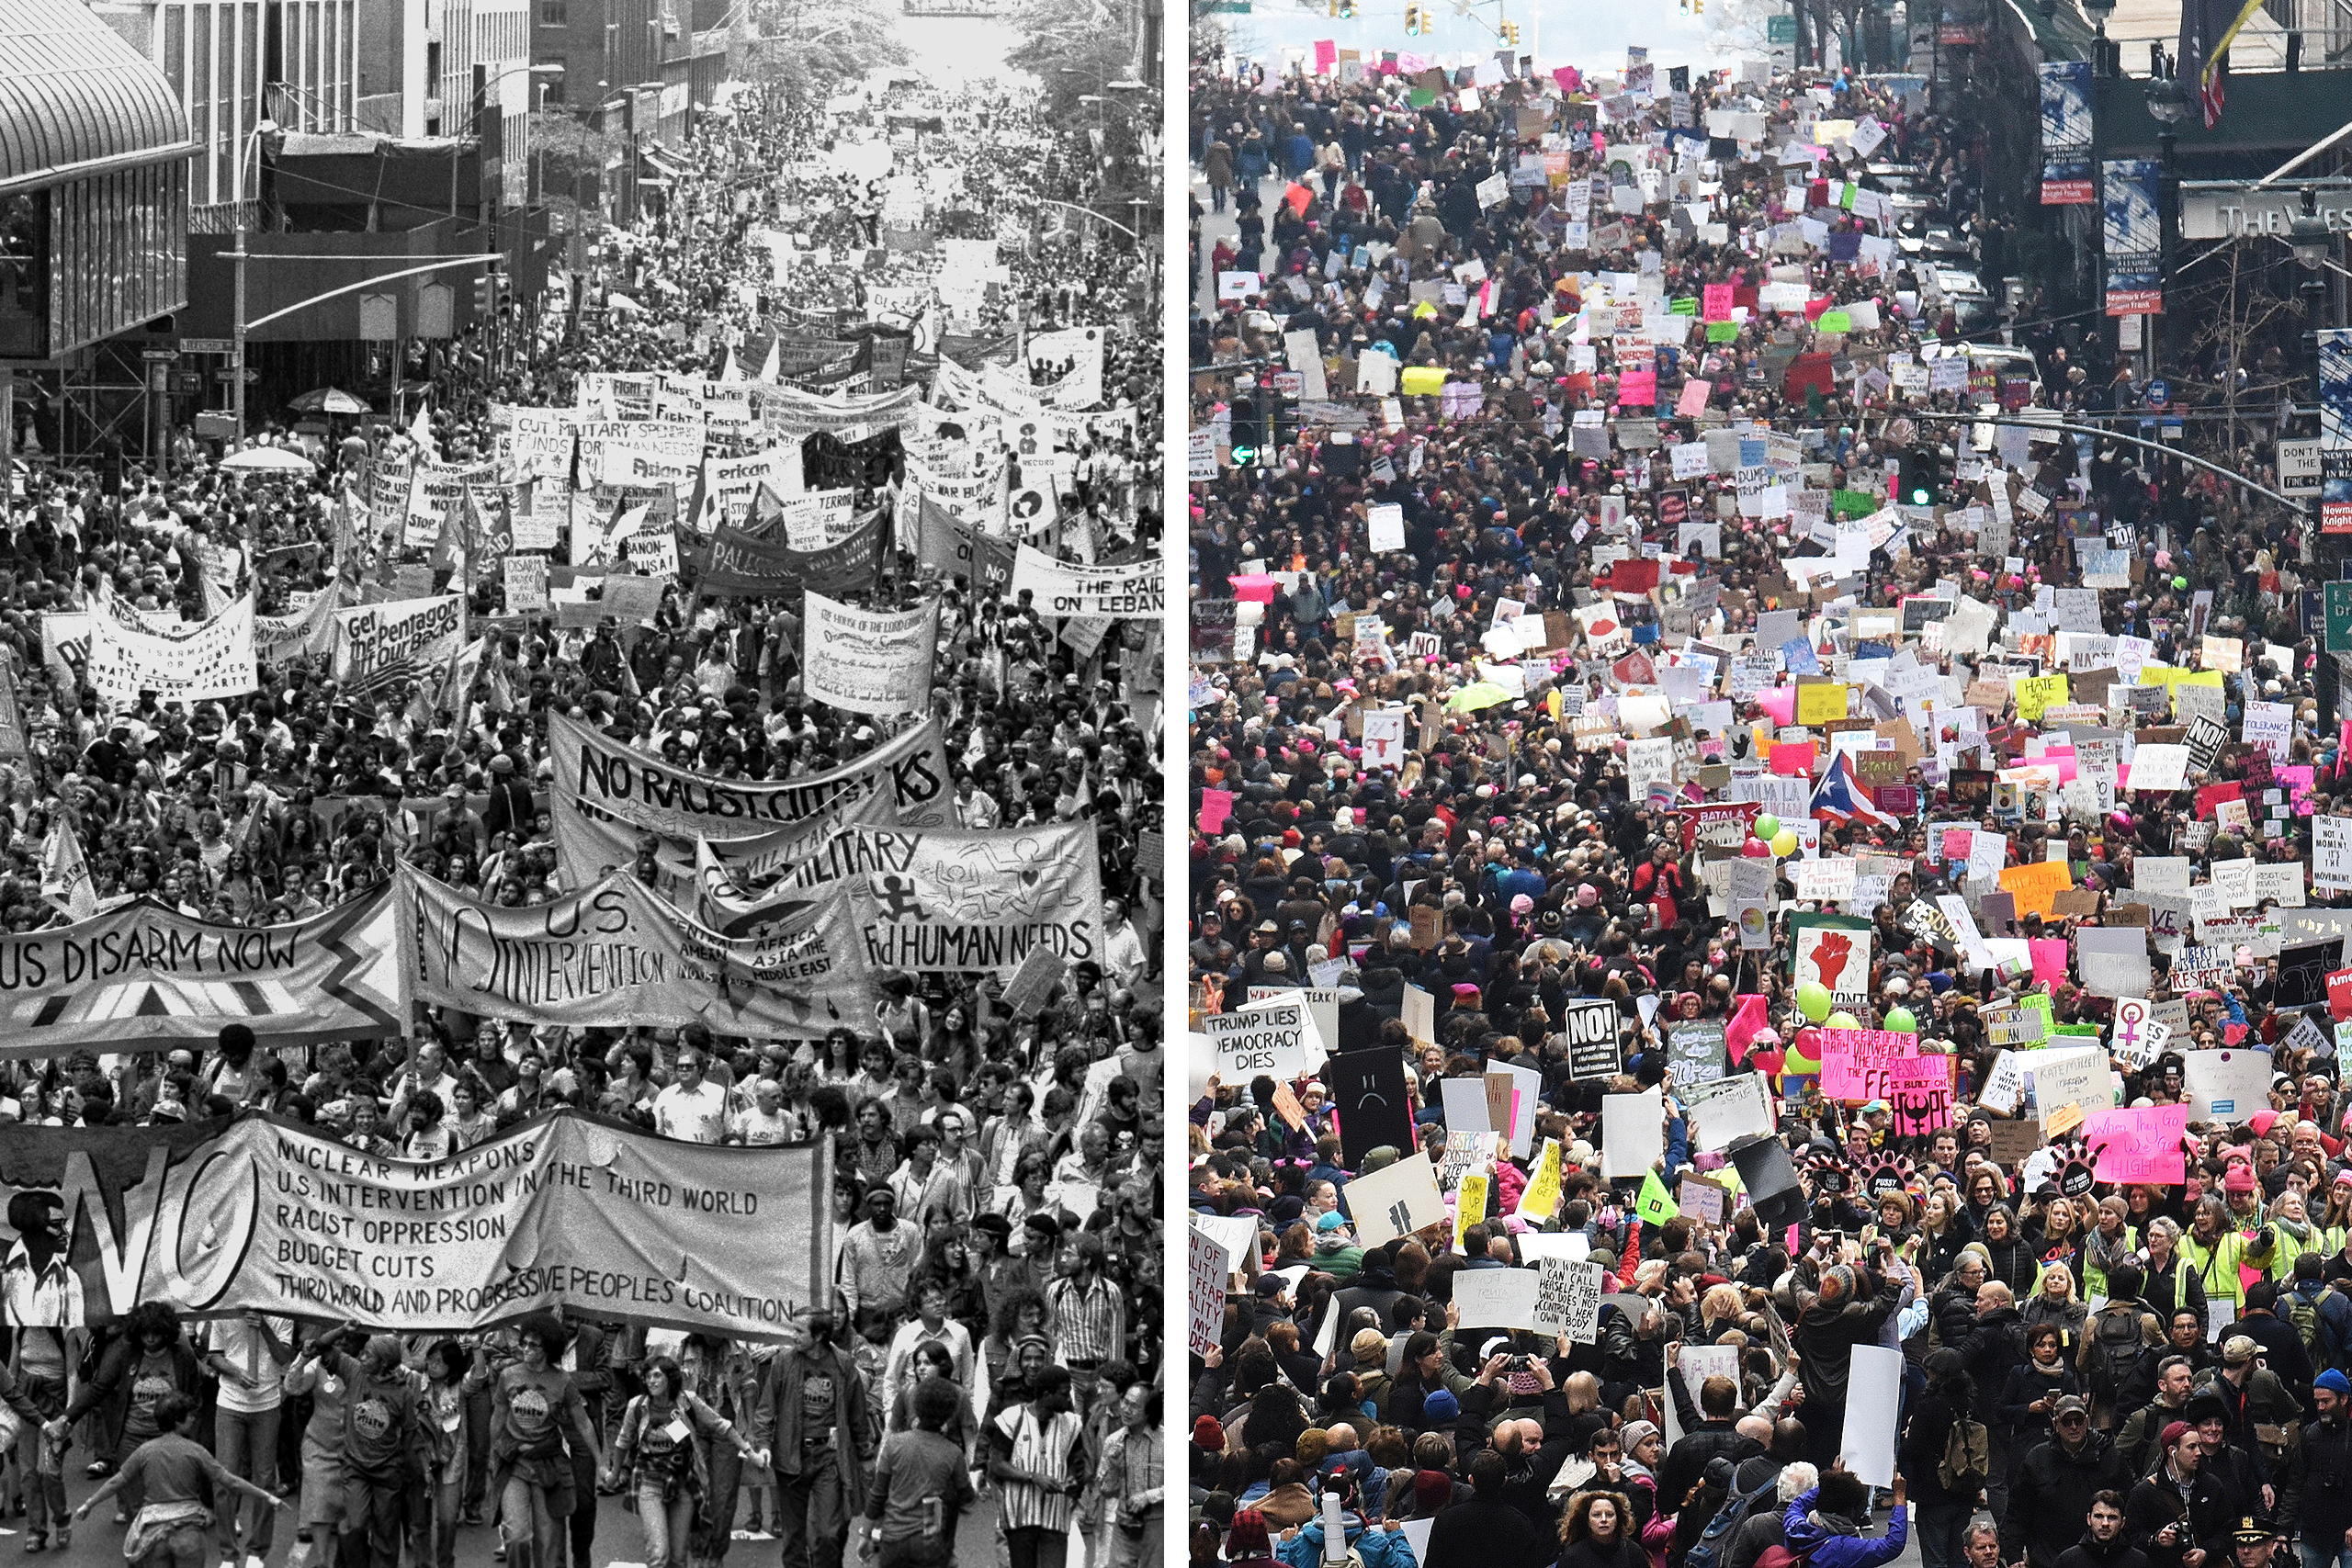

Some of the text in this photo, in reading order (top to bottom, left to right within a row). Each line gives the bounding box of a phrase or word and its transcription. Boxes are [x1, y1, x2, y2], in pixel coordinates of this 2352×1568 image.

[2220, 205, 2279, 231] THE
[518, 417, 630, 439] CUT MILITARY
[2283, 447, 2313, 458] DON'T
[383, 463, 404, 477] OUT
[633, 457, 682, 479] Asian
[2297, 458, 2316, 468] THE
[820, 493, 853, 510] TERROR
[408, 513, 436, 529] STOP
[986, 563, 1007, 583] NO
[1075, 579, 1113, 595] THE
[1055, 595, 1082, 613] ON
[348, 596, 459, 649] Get Pentagon
[834, 613, 856, 629] HOUSE
[884, 619, 904, 634] LORD
[410, 617, 460, 651] Backs
[1415, 636, 1437, 655] NO
[2025, 677, 2054, 694] HATE
[2188, 718, 2227, 750] NO!
[2245, 718, 2290, 733] TOLERANCE
[579, 745, 759, 819] NO RACIST
[1700, 808, 1746, 821] BATALA
[2319, 816, 2342, 829] THIS IS
[2323, 829, 2335, 839] NOT
[2324, 859, 2341, 868] THE
[2327, 850, 2341, 860] IT'S
[1803, 860, 1856, 874] JUSTICE
[1871, 875, 1887, 888] YOU
[2008, 873, 2063, 892] HEALTH
[2194, 887, 2216, 899] THIS
[2193, 899, 2218, 911] PUSSY
[415, 882, 638, 993] NO U.S.
[753, 923, 820, 952] AFRICA
[900, 923, 1003, 967] HUMAN
[0, 925, 303, 990] US DISARM NOW
[752, 939, 828, 968] ASIA THE
[2216, 958, 2232, 968] AND
[498, 937, 665, 1005] INTERVENTION
[752, 956, 831, 982] MIDDLE EAST
[2172, 968, 2222, 990] RESPECT
[1208, 1010, 1297, 1032] TRUMP LIES
[1569, 1006, 1614, 1045] NO!
[1989, 1010, 2022, 1025] WOMENS
[1824, 1028, 1913, 1046] THE NEEDS OF THE
[1990, 1026, 2019, 1044] HUMAN
[1823, 1040, 1905, 1058] MANY OUTWEIGH
[1236, 1052, 1275, 1071] DIES
[1853, 1055, 1871, 1068] THE
[2039, 1063, 2064, 1079] KATE
[1847, 1066, 1862, 1078] THE
[1904, 1077, 1949, 1089] BUILT ON
[1996, 1082, 2013, 1094] HER
[2091, 1116, 2127, 1135] When
[2132, 1111, 2159, 1145] They
[2162, 1110, 2180, 1127] Go
[1447, 1130, 1488, 1152] RESPECT
[2125, 1135, 2177, 1155] We Go
[2110, 1156, 2157, 1179] HIGH!
[277, 1162, 758, 1216] U.S. INTERVENTION IN THE THIRD WORLD
[1536, 1187, 1554, 1198] GET
[1875, 1178, 1898, 1188] PUSSY
[62, 1137, 536, 1315] NO NUCLEAR WEAPONS
[277, 1204, 505, 1245] RACIST OPPRESSION
[277, 1239, 435, 1279] BUDGET CUTS
[1204, 1245, 1221, 1264] OF
[1544, 1258, 1592, 1275] NO WOMAN
[1547, 1269, 1595, 1286] CAN CALL
[276, 1265, 794, 1324] THIRD WORLD AND PROGRESSIVE PEOPLES COALITION
[1196, 1277, 1224, 1308] FEAR
[1539, 1278, 1600, 1300] HERSELF FREE
[1538, 1299, 1594, 1320] CONTROL HER
[1539, 1290, 1600, 1311] WHO DOES NOT
[1193, 1317, 1212, 1337] MY
[1540, 1312, 1589, 1330] OWN BODY
